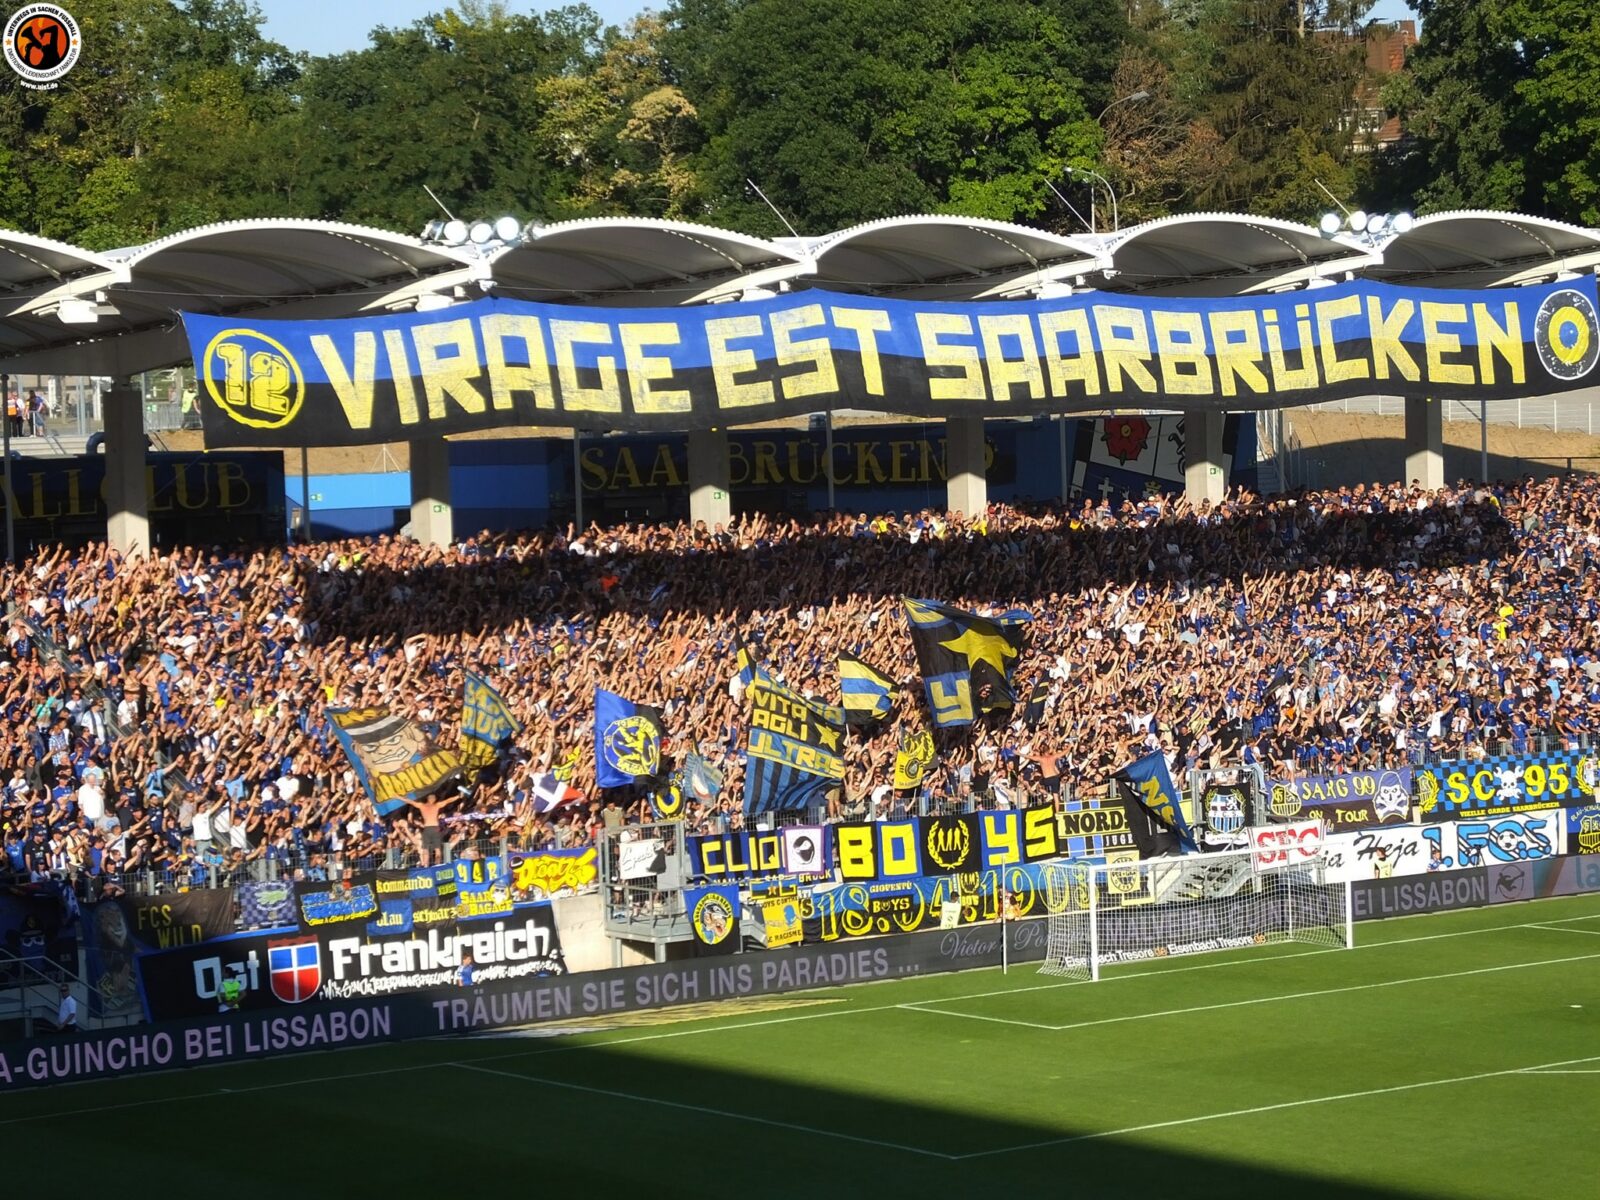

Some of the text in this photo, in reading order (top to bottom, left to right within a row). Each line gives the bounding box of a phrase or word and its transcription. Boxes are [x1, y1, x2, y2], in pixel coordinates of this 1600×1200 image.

[310, 294, 1525, 429] VIRAGE EST SAARBRÜCKEN
[747, 729, 846, 778] ULTRAS
[1352, 775, 1376, 796] 99
[1447, 763, 1569, 803] SC 95
[1335, 809, 1369, 823] TOUR
[1381, 875, 1486, 913] LISSABON
[137, 904, 172, 930] FCS
[329, 919, 550, 980] Frankreich
[433, 985, 571, 1030] TRÄUMEN
[582, 979, 624, 1012] SIE
[635, 972, 698, 1006] SICH
[710, 963, 753, 996] INS
[762, 948, 889, 989] PARADIES
[184, 1025, 232, 1061] BEI
[244, 1006, 391, 1053] LISSABON
